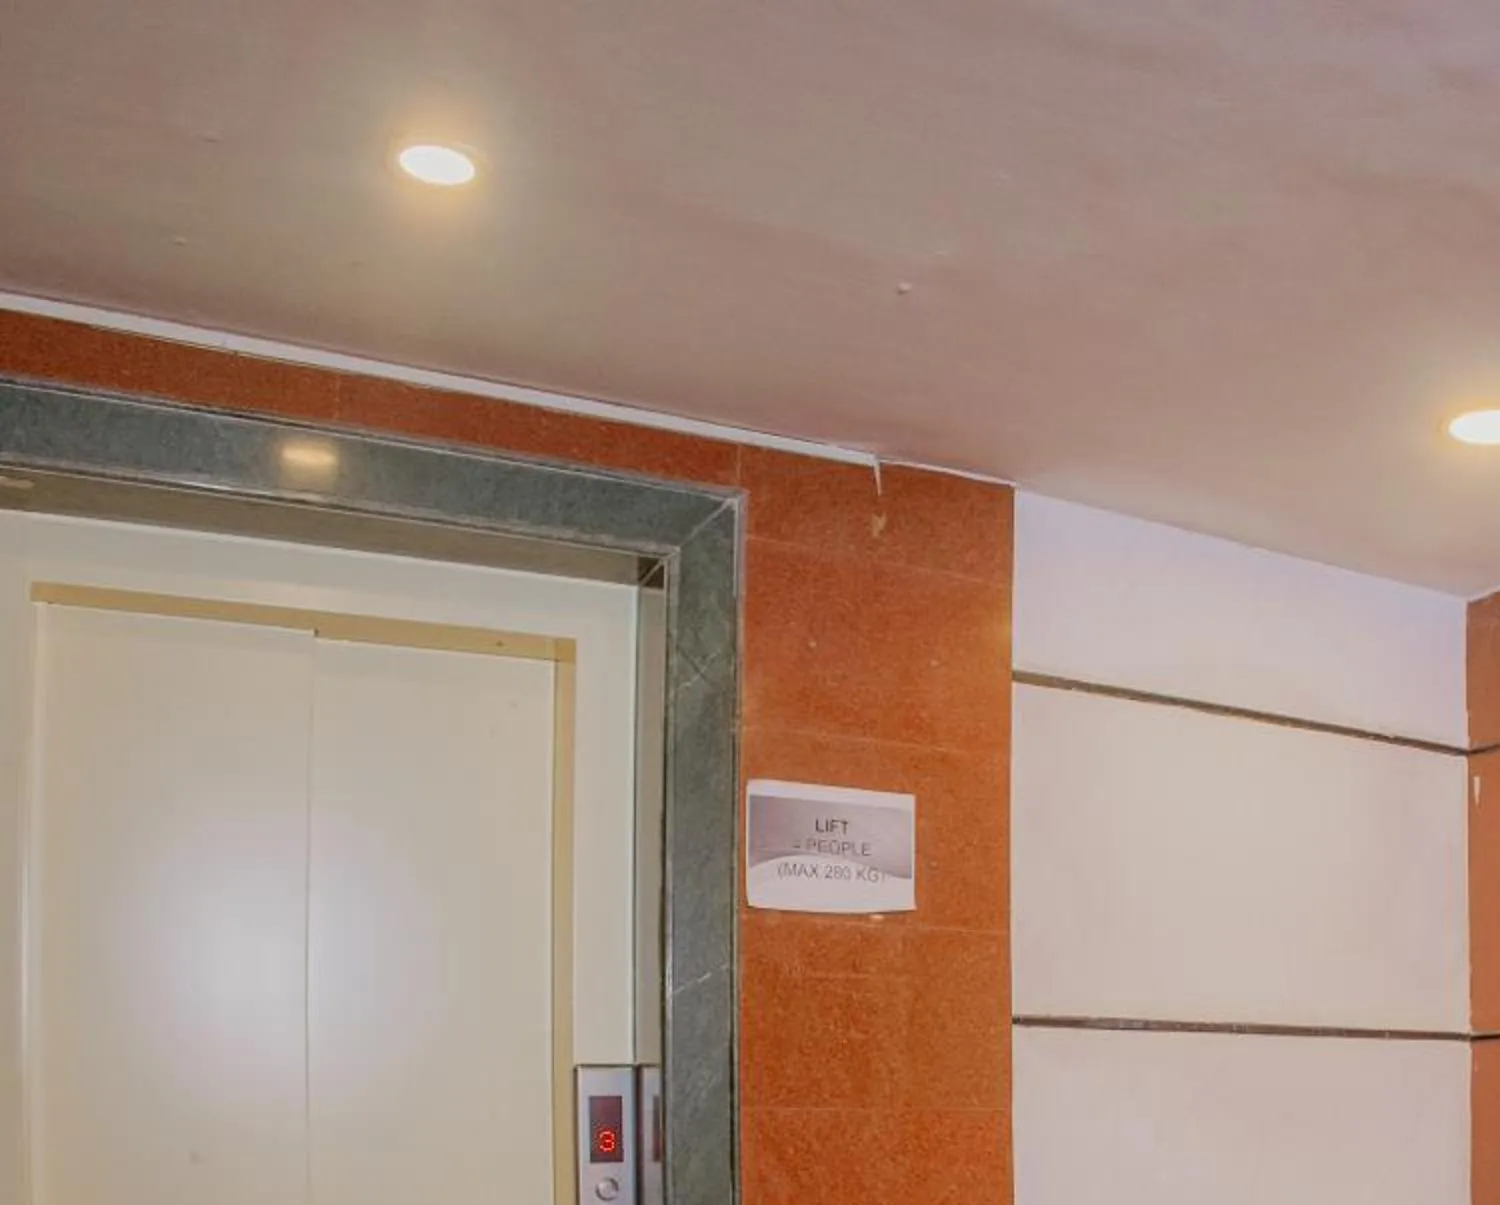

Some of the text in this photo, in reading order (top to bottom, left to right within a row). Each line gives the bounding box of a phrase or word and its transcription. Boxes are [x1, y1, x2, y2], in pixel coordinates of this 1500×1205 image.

[815, 817, 848, 834] LIFT
[806, 838, 873, 856] PEOPLE
[777, 862, 817, 880] (MAX
[598, 1130, 616, 1153] 3
